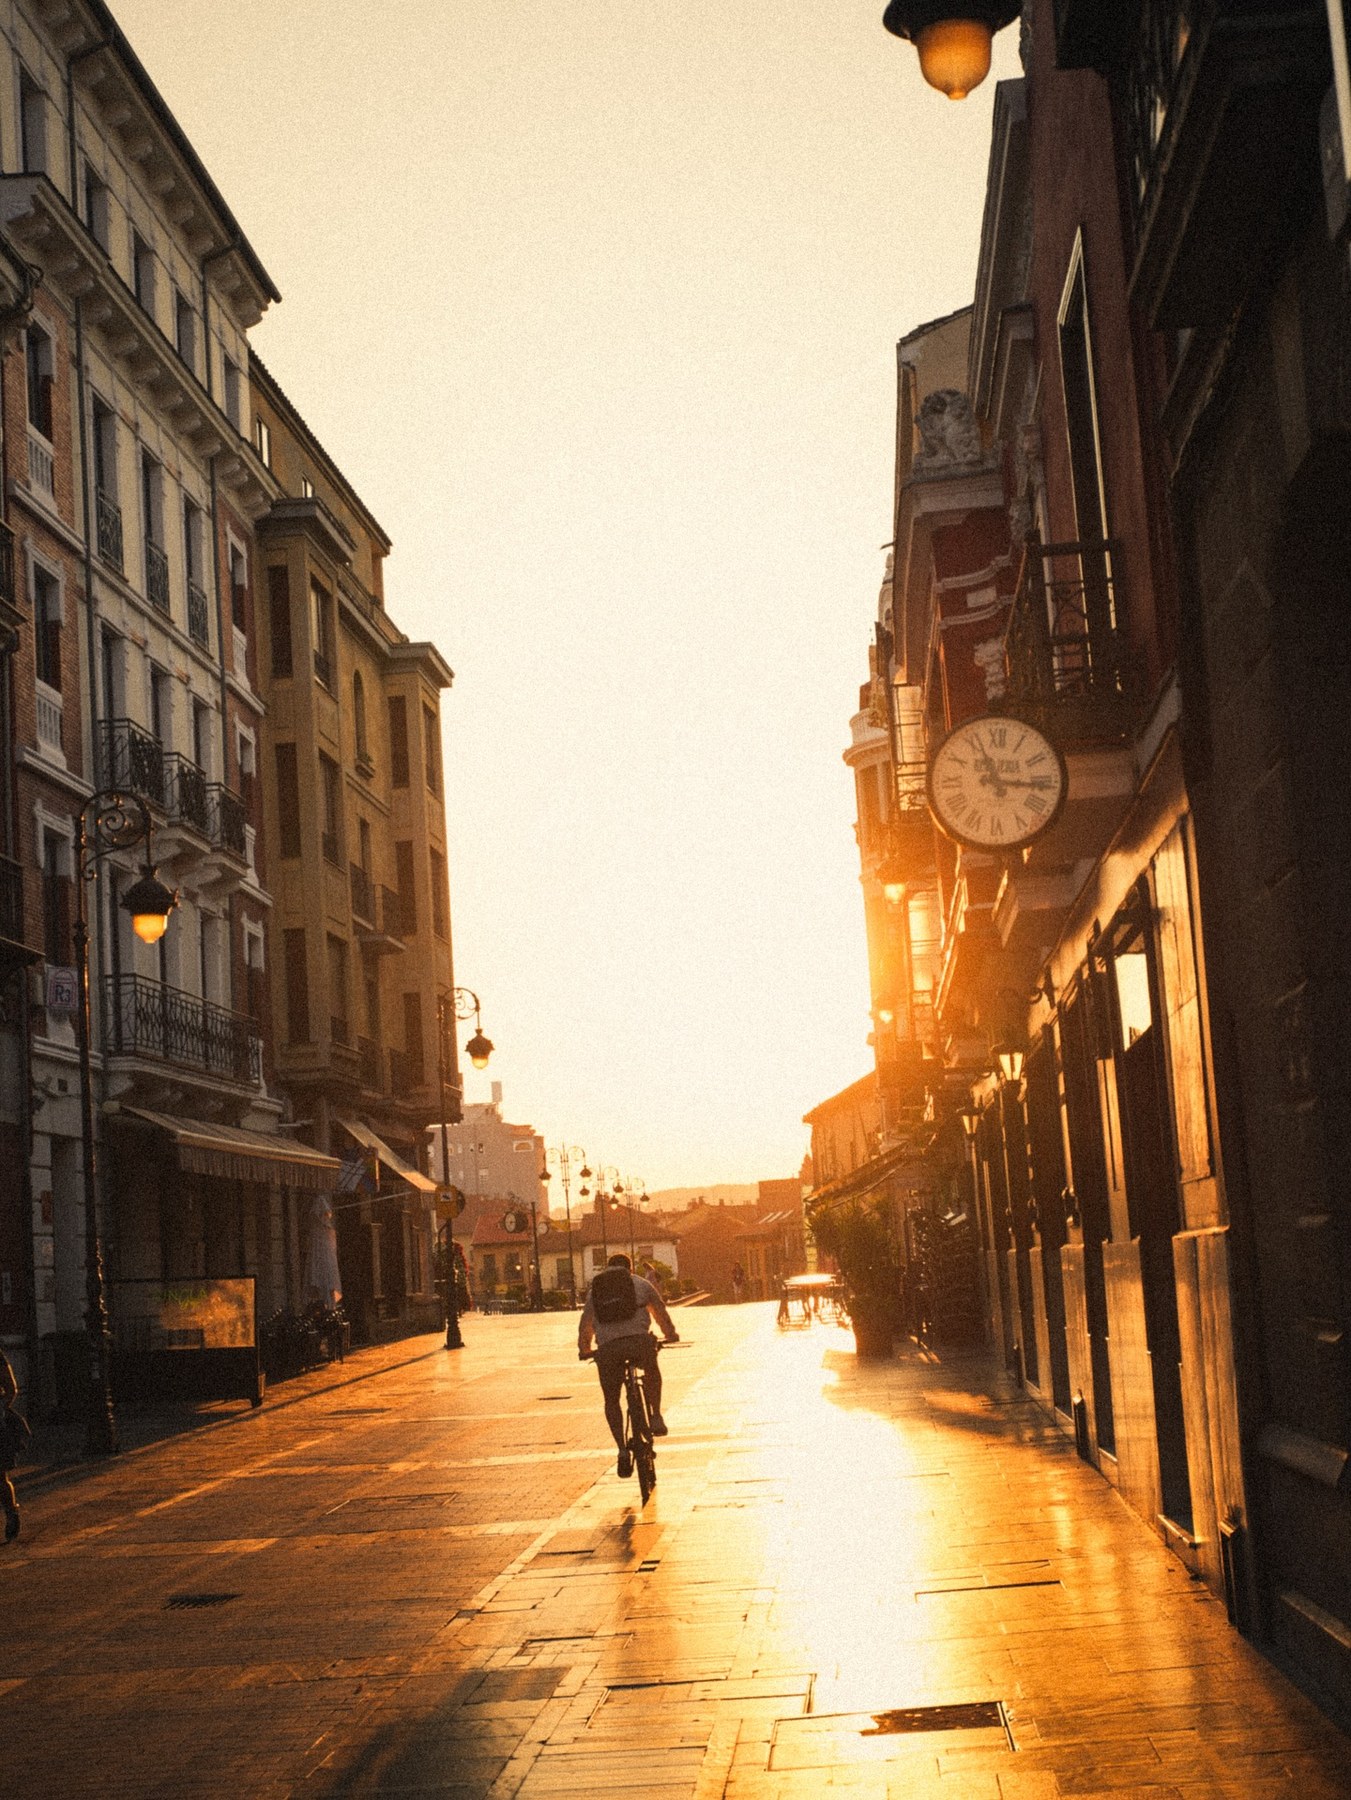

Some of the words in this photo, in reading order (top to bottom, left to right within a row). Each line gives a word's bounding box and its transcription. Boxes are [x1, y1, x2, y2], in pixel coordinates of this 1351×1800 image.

[989, 728, 1007, 747] XII
[1012, 735, 1026, 754] I
[1026, 752, 1046, 767] II
[989, 815, 1005, 836] VI
[55, 984, 71, 1003] R3
